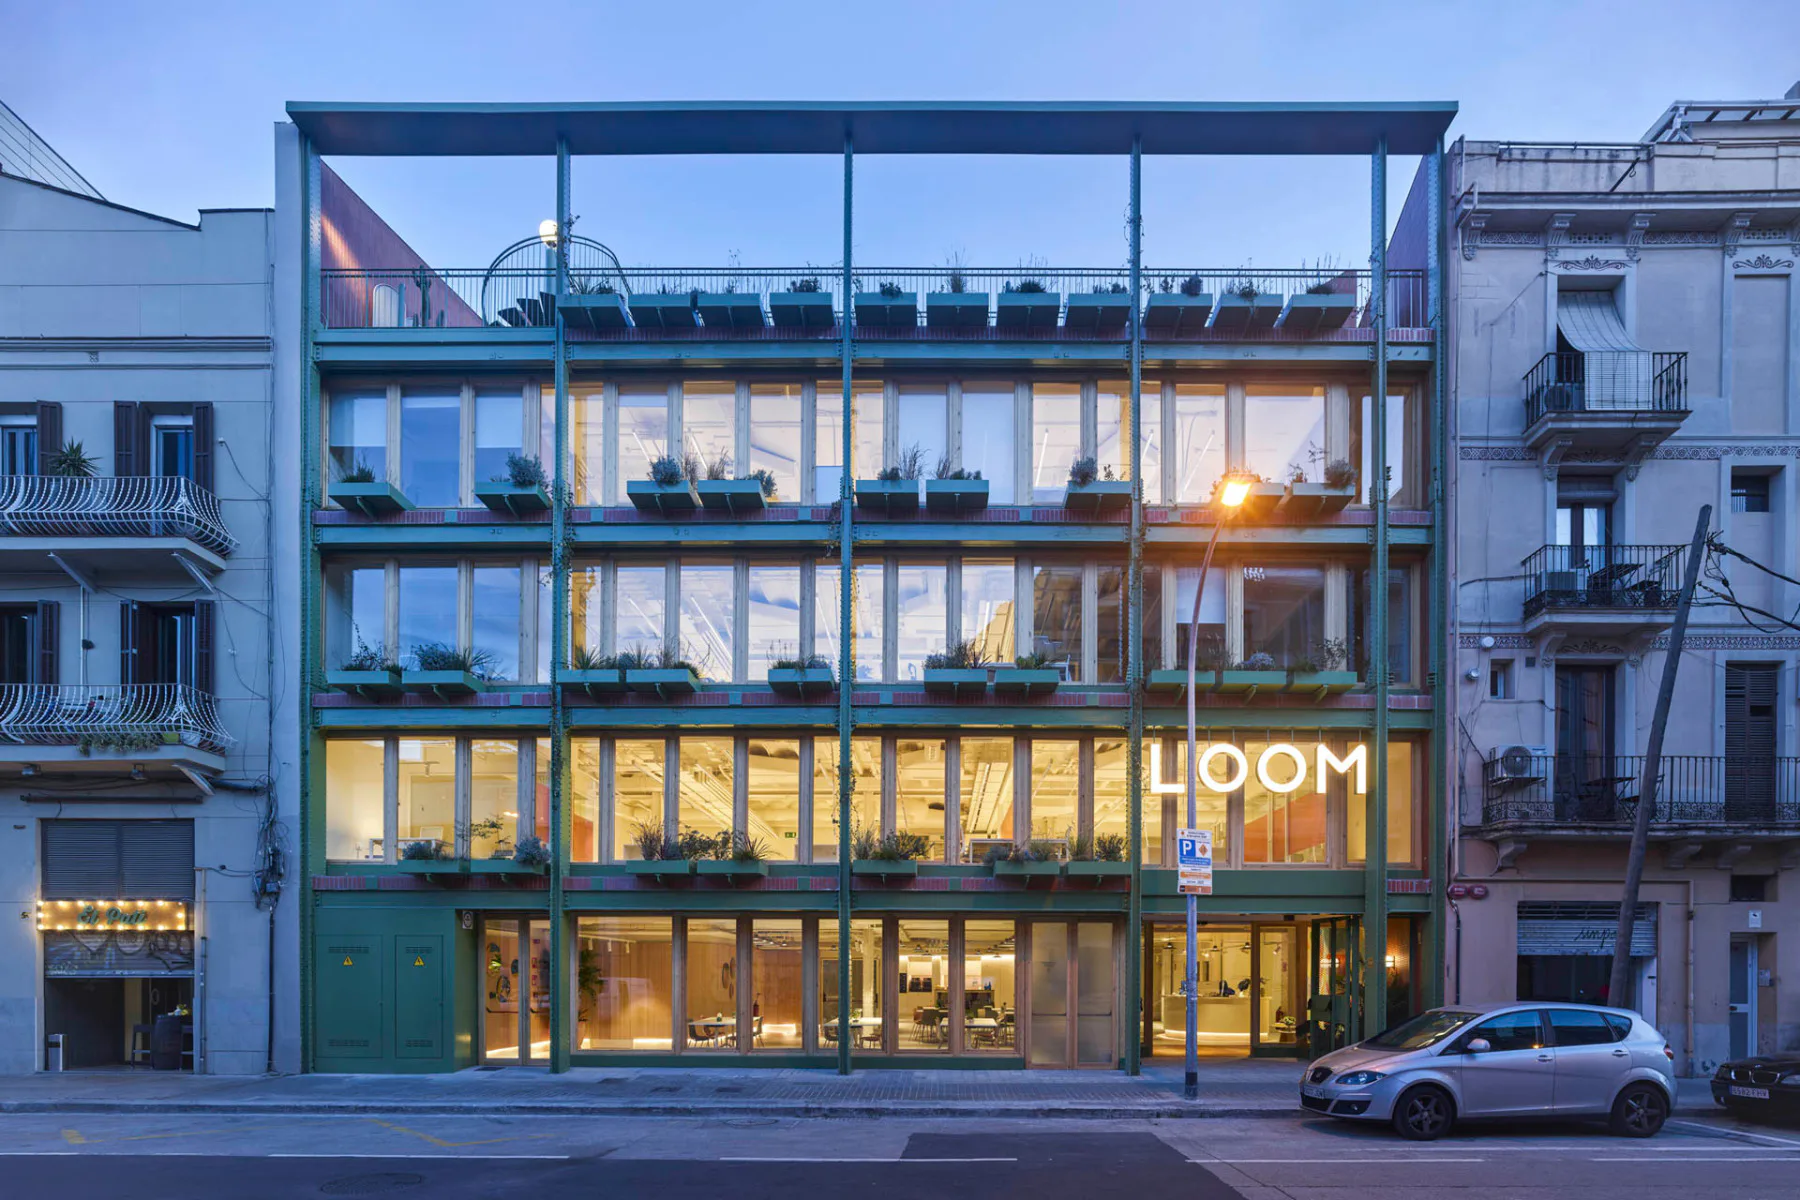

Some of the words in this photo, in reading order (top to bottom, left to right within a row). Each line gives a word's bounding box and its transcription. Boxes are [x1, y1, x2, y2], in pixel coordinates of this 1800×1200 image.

[1150, 743, 1367, 794] LOOM
[1182, 840, 1192, 855] P
[77, 905, 100, 925] El
[105, 907, 148, 925] Pati
